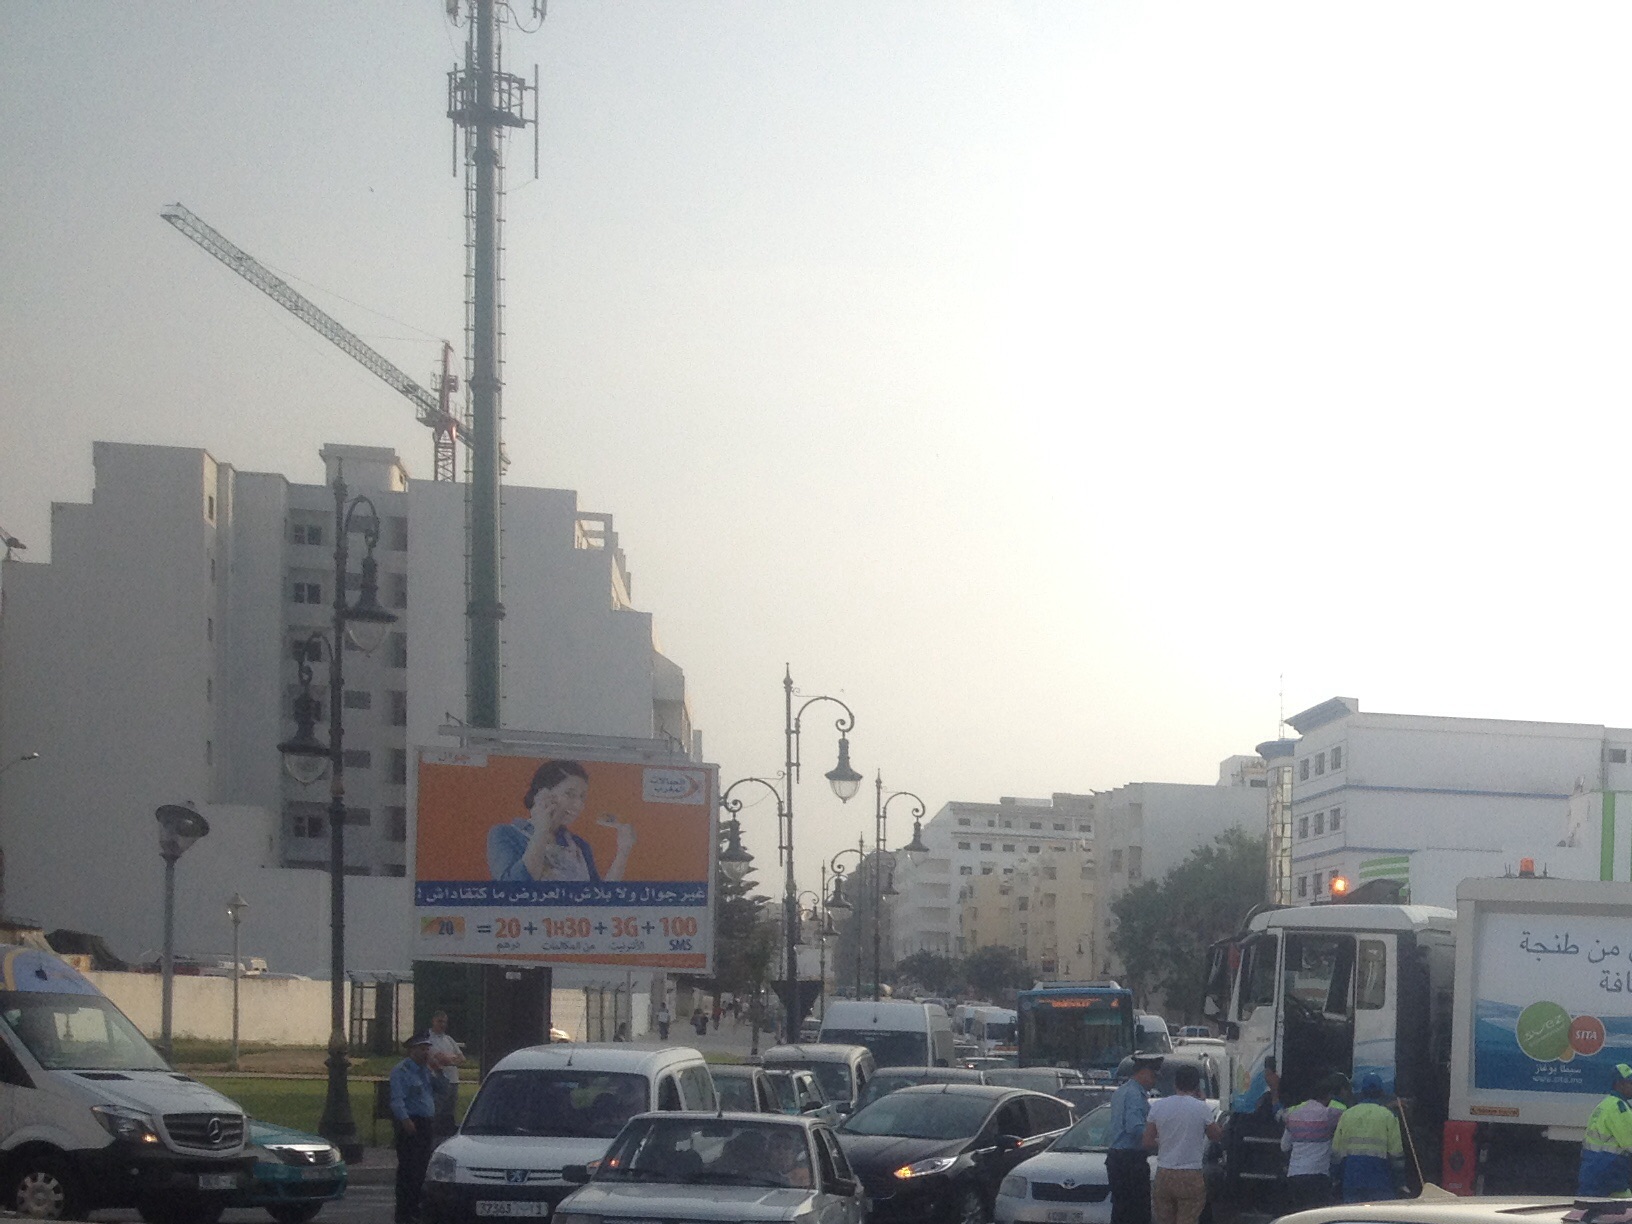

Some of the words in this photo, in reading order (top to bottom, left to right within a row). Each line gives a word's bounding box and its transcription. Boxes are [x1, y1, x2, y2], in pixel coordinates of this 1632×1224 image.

[493, 888, 505, 899] ما
[509, 887, 566, 902] العروض
[640, 886, 677, 902] جوال
[680, 887, 706, 902] غير
[495, 916, 521, 938] 20
[542, 916, 591, 938] 1H30
[611, 916, 639, 938] 3G
[659, 916, 698, 938] 100
[669, 938, 693, 951] SMS
[1520, 930, 1580, 962] طنجة
[1588, 939, 1620, 963] من
[1575, 1030, 1598, 1040] SITA
